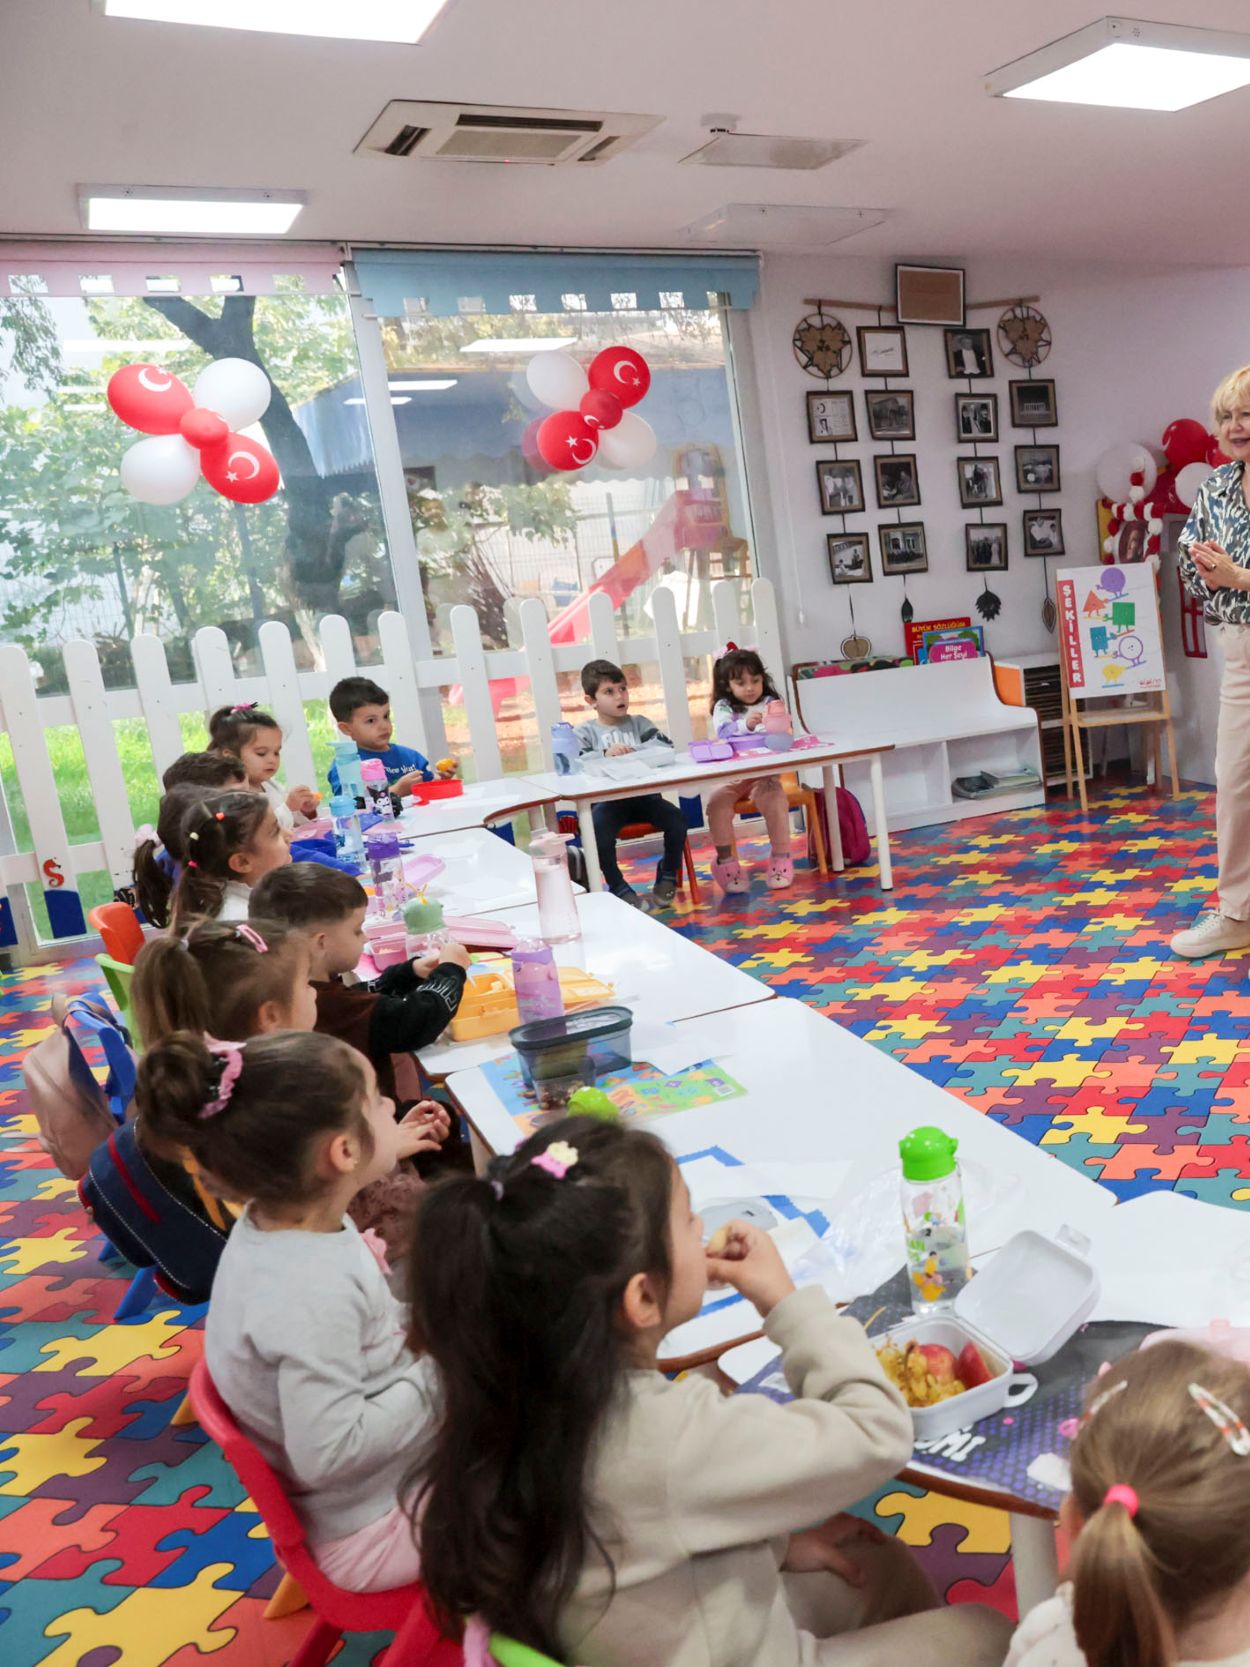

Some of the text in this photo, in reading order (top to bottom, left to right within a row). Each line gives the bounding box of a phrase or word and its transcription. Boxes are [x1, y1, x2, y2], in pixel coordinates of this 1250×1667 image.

[1062, 584, 1082, 684] ŞEKİLLER
[945, 644, 962, 653] Bilge
[940, 653, 952, 661] Her
